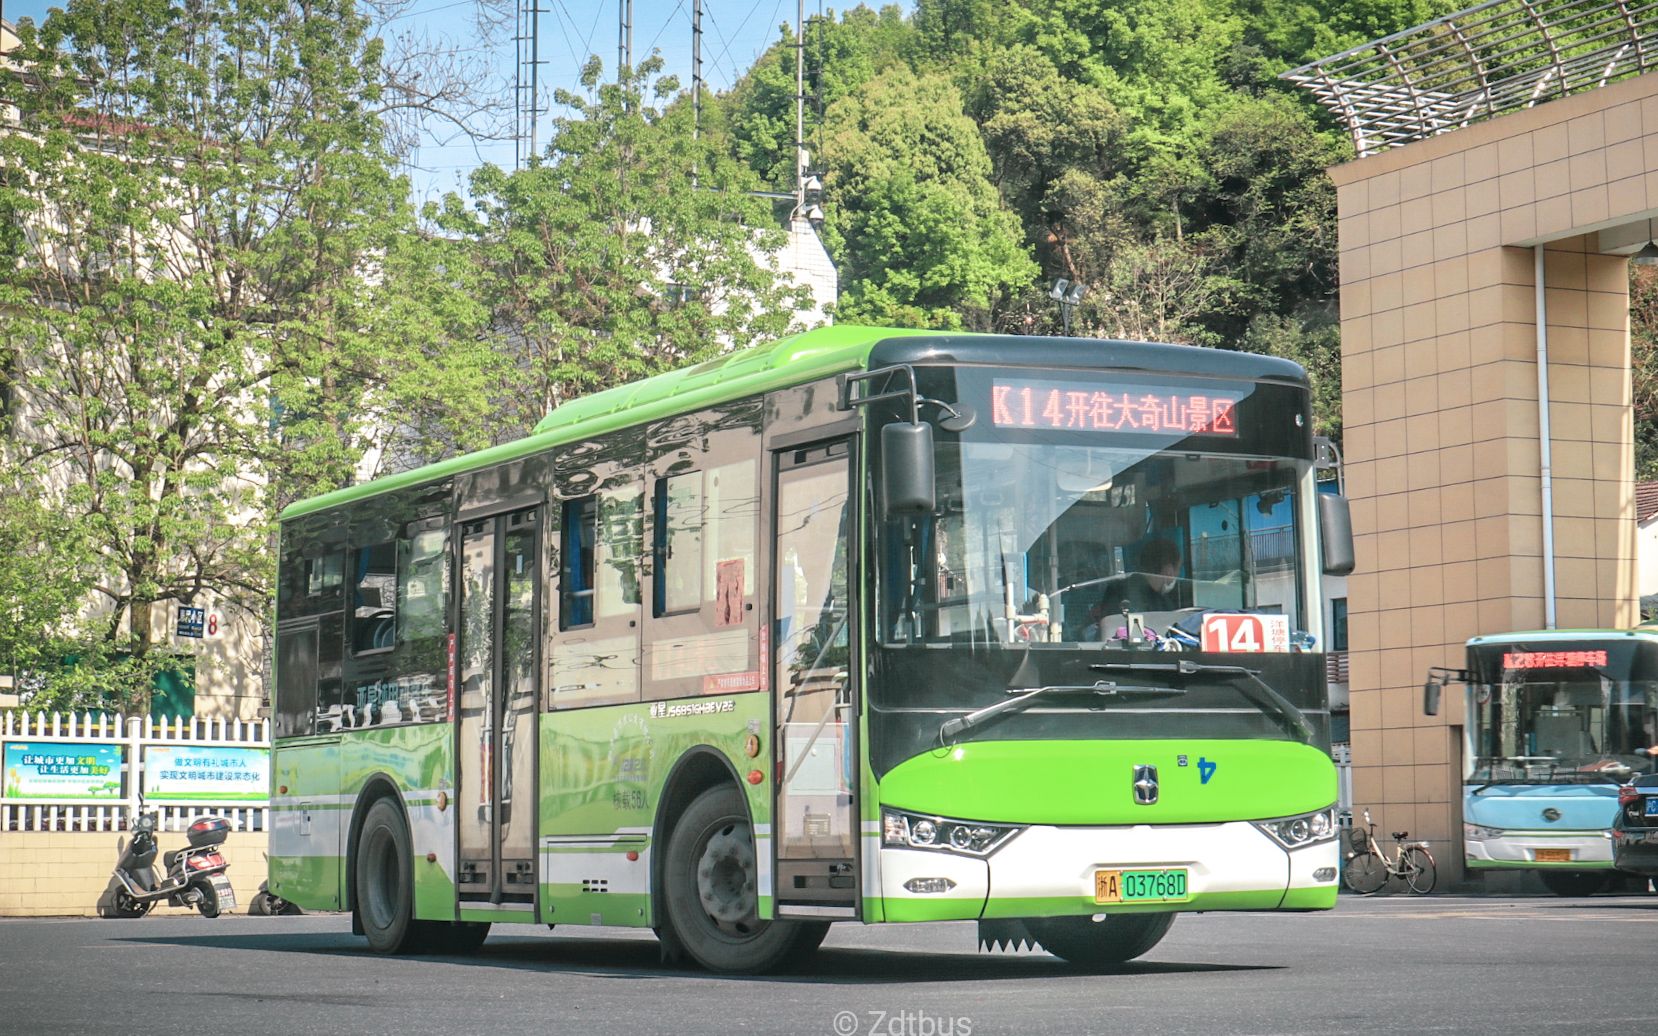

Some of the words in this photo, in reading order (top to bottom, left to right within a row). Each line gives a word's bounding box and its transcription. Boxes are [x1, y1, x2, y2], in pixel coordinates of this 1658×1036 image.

[208, 614, 218, 635] 8
[1208, 618, 1260, 652] 14
[23, 755, 97, 765] 让城市更加文明
